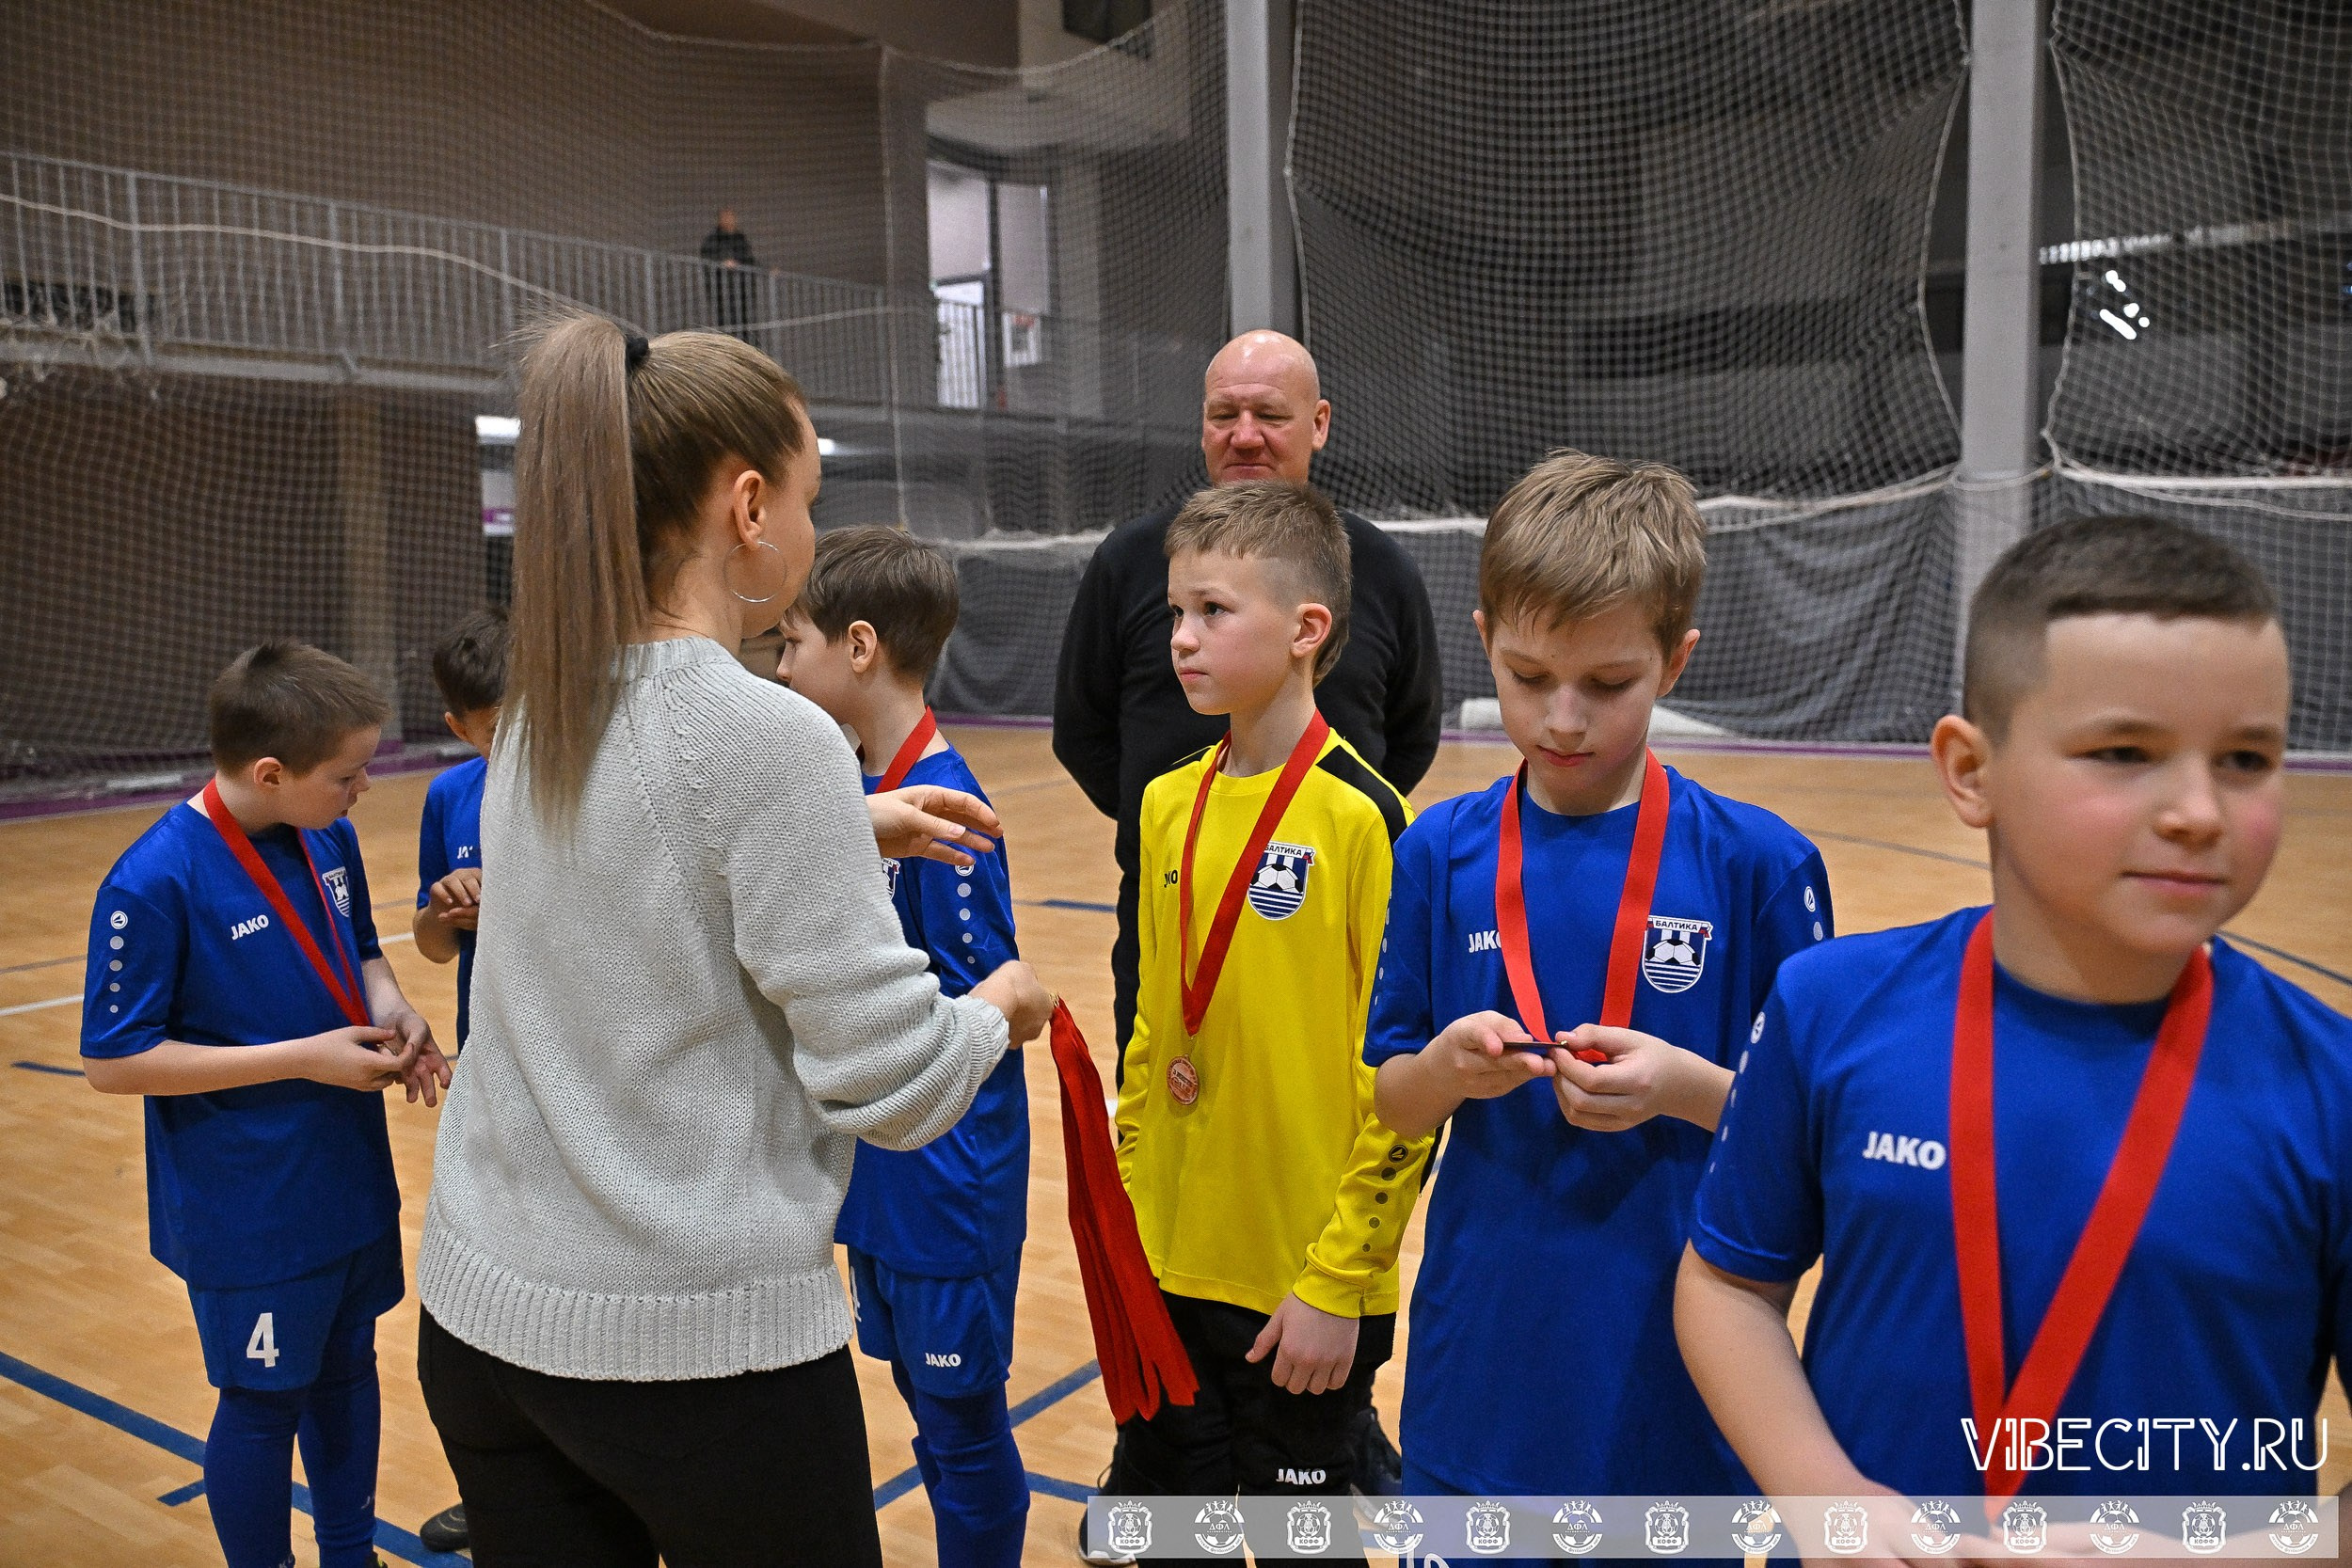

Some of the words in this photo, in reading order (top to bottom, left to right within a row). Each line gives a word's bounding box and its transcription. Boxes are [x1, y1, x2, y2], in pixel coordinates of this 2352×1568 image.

[231, 914, 269, 940] JAKO
[1655, 920, 1698, 931] БАЛТИКА
[1863, 1131, 1947, 1170] JAKO
[246, 1312, 280, 1368] 4
[925, 1353, 961, 1368] JAKO
[1276, 1468, 1327, 1485] JAKO
